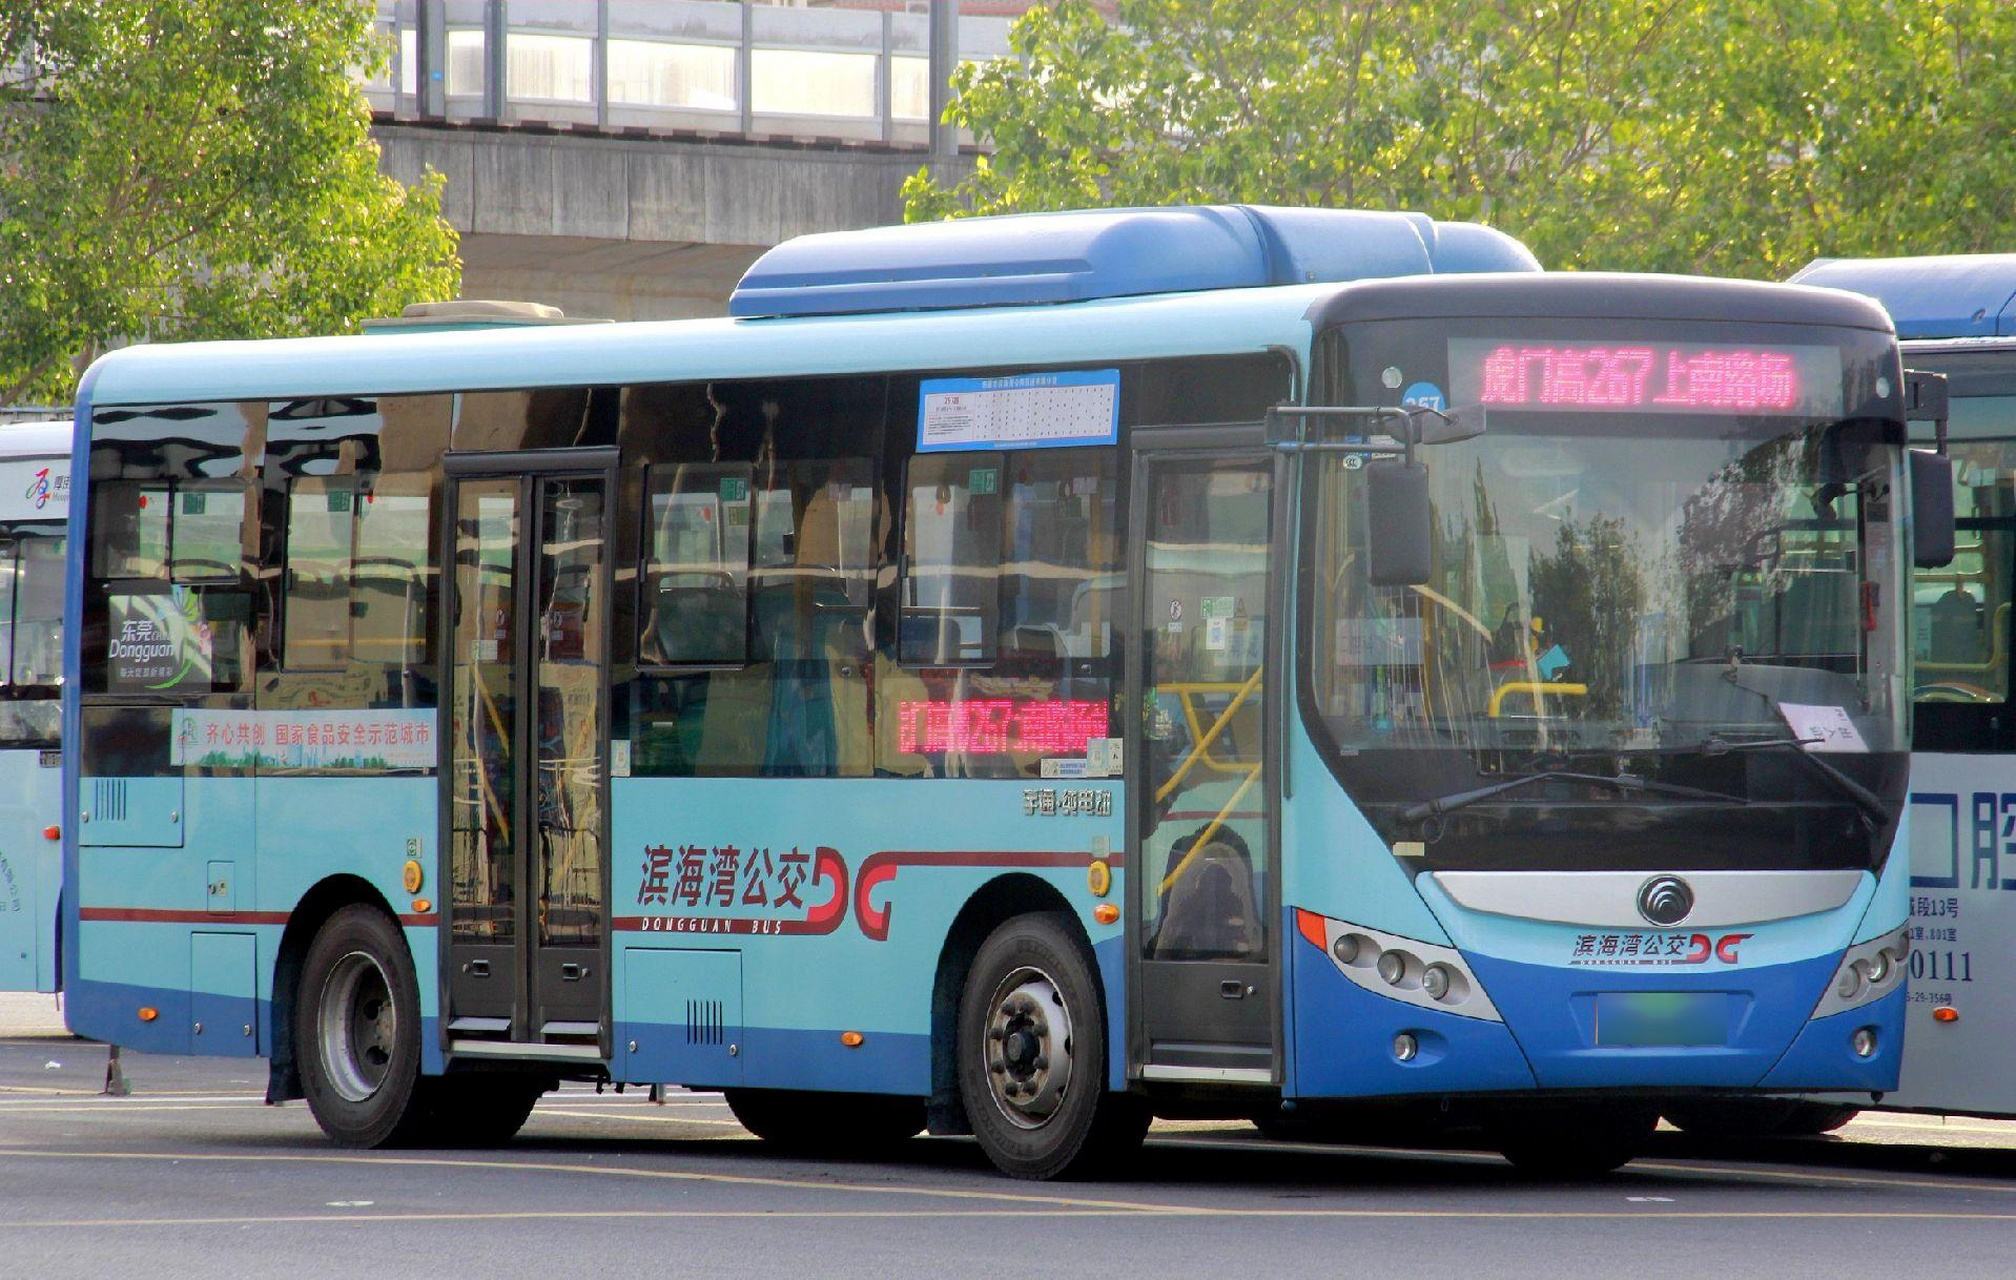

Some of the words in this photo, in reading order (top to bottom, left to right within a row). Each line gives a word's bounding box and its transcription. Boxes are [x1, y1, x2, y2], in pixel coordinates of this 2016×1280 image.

[121, 620, 152, 641] 东莞
[109, 639, 174, 663] Dongguan
[206, 723, 265, 746] 齐心共创
[275, 723, 430, 746] 国家食品安全示范城市
[637, 844, 810, 909] 滨海湾公交
[642, 917, 732, 933] DONGGUAN
[752, 920, 782, 935] BUS
[1573, 934, 1688, 956] 滨海湾公交
[1910, 949, 1974, 982] 0111
